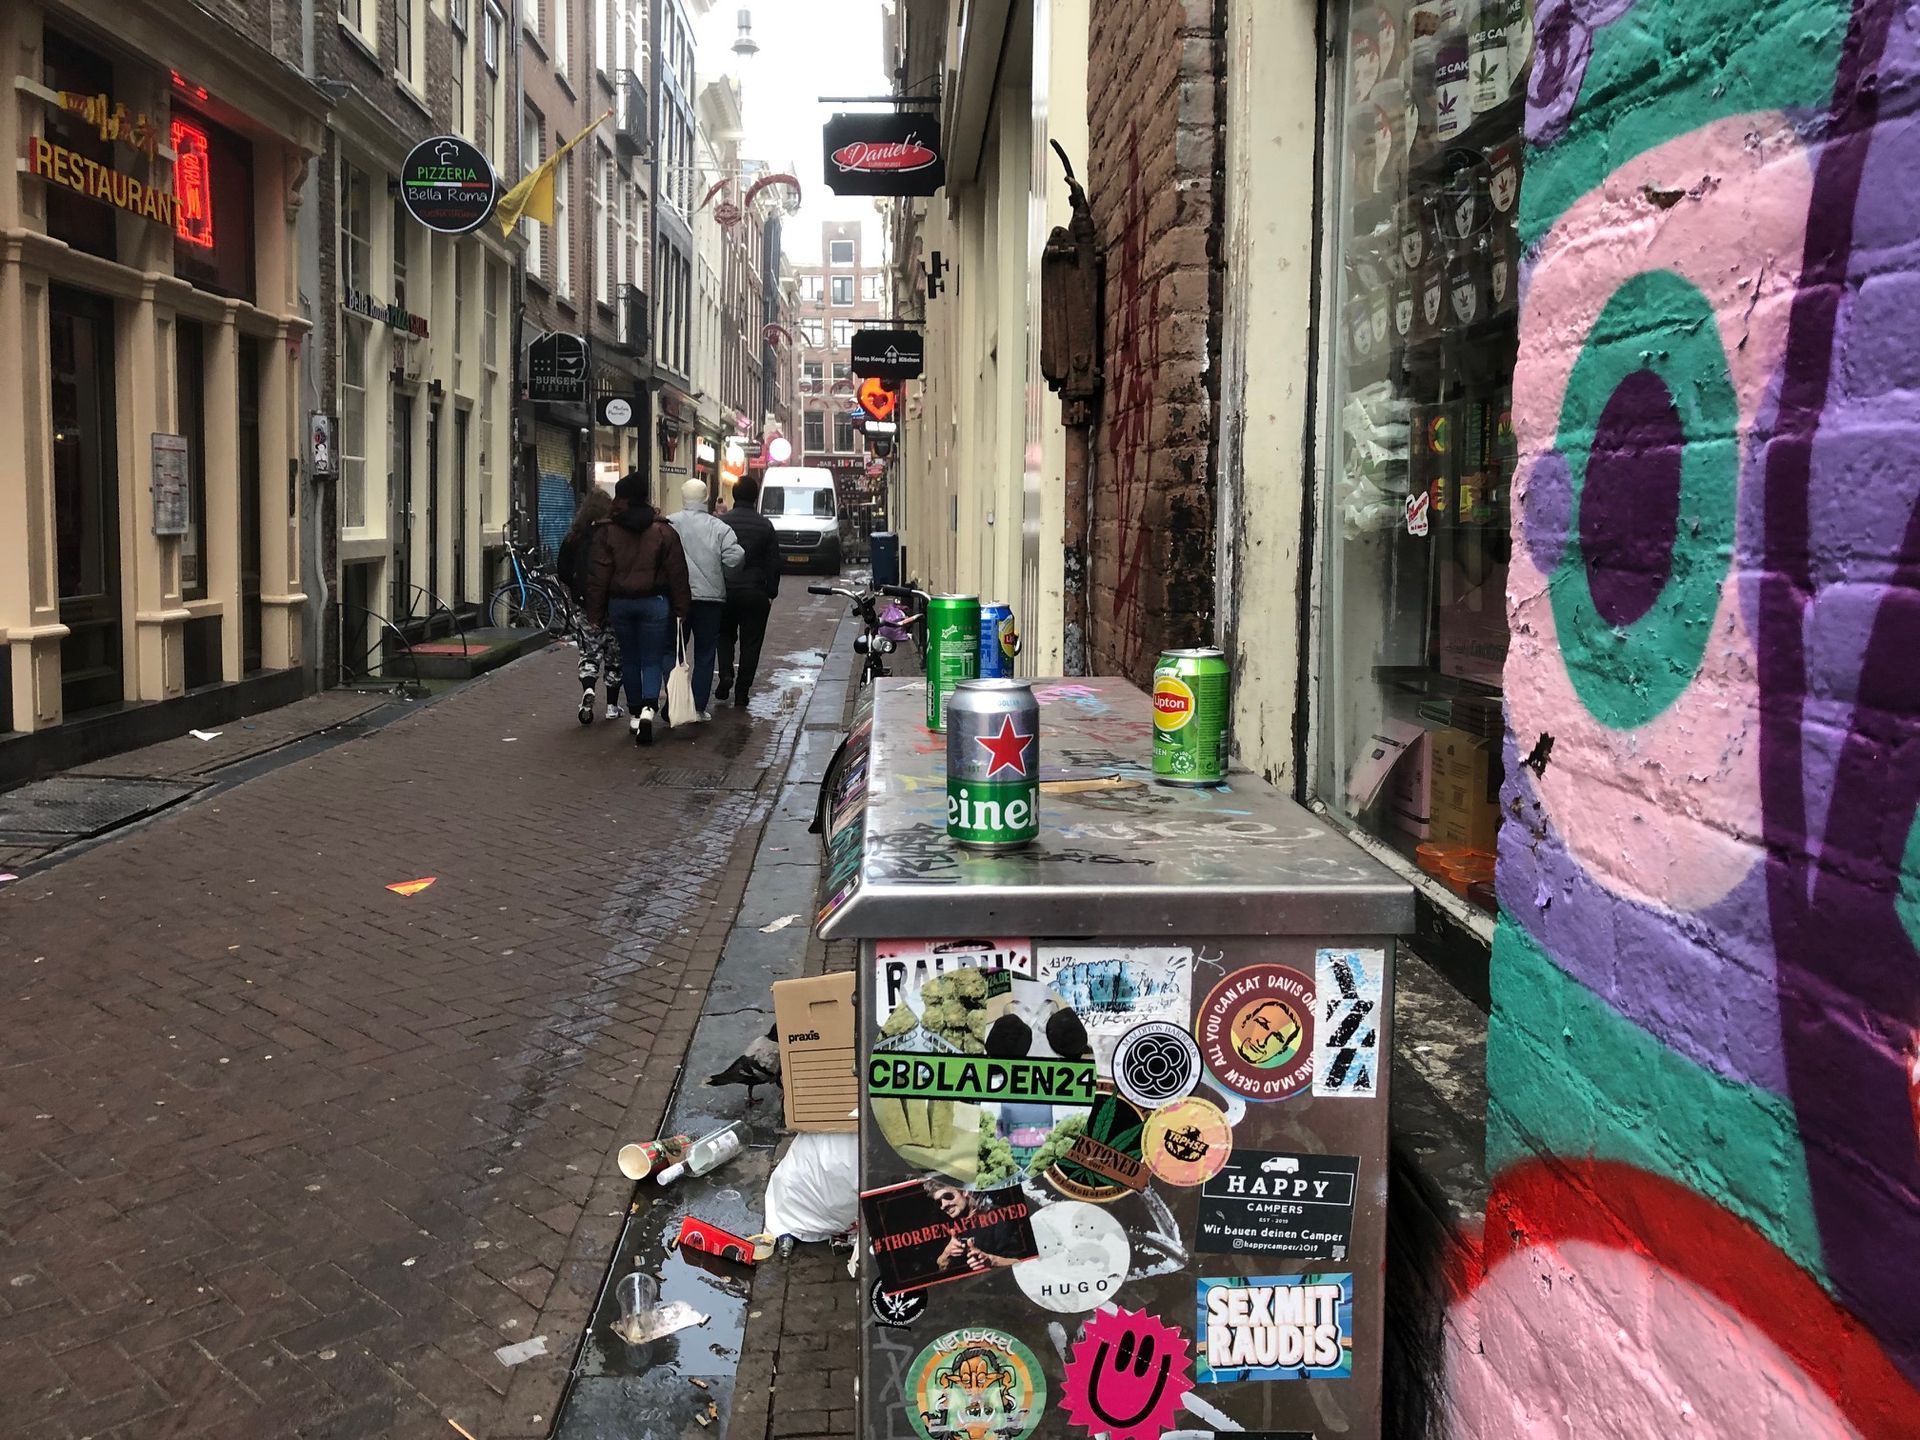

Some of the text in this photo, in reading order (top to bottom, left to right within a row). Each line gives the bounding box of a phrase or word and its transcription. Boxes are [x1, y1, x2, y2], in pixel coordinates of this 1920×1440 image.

[840, 131, 924, 172] Daniel's
[36, 137, 184, 228] RESTAURANT
[417, 166, 477, 181] PIZZERIA
[408, 187, 488, 202] Bella Roma
[854, 355, 870, 363] Hong
[870, 355, 886, 363] Kong
[535, 375, 577, 386] BURGER
[1154, 694, 1185, 709] Lipton
[1236, 975, 1261, 995] EAT
[1267, 975, 1304, 997] DAVIS
[1214, 988, 1239, 1014] CAN
[788, 1029, 820, 1045] praxis
[1206, 1015, 1222, 1042] YOU
[1121, 1024, 1198, 1058] MALDITOS BARBEROS
[1208, 1044, 1227, 1067] ALL
[868, 1058, 1096, 1098] CBDLADEN24
[1224, 1068, 1261, 1093] CREW
[1263, 1074, 1296, 1094] MAD
[1167, 1131, 1207, 1153] TRPHSE
[1226, 1175, 1330, 1198] HAPPY
[1246, 1202, 1303, 1214] CAMPERS
[873, 1202, 1029, 1254] #THORBENAPPROVED
[1203, 1223, 1343, 1243] Wir bauen deinen Camper
[1041, 1279, 1108, 1296] HUGO
